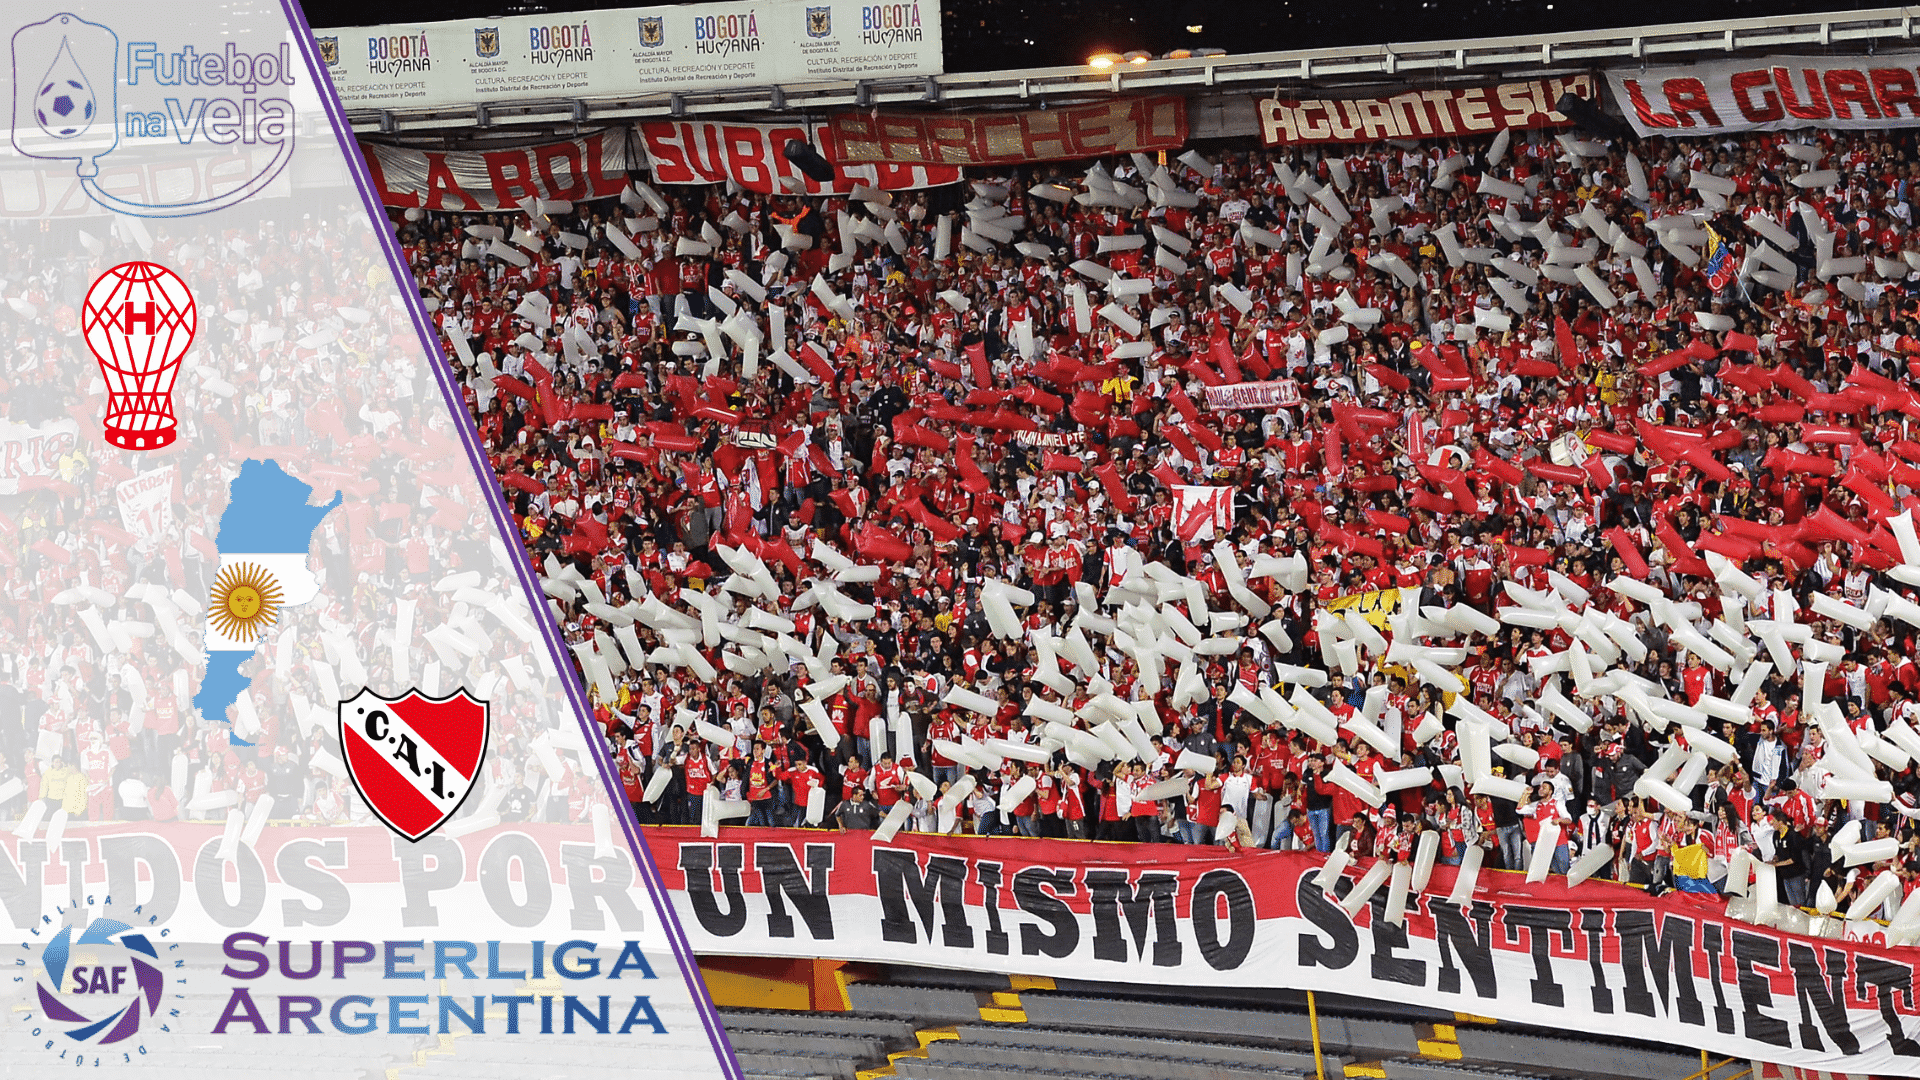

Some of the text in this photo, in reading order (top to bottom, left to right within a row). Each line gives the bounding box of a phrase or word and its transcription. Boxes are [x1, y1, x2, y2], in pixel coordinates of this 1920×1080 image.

[695, 9, 758, 39] BOGOTÁ
[862, 0, 921, 30] BOGOTÁ
[368, 30, 429, 60] BOGOTÁ
[530, 20, 592, 50] BOGOTÁ
[724, 62, 755, 71] DEPORTE
[889, 52, 917, 61] DEPORTE
[395, 81, 426, 89] DEPORTE
[557, 72, 588, 80] DEPORTE
[1259, 86, 1497, 144] AGUANTE
[1623, 77, 1724, 128] LA
[832, 97, 1188, 165] PARCHE 10
[392, 832, 646, 933] POR
[678, 842, 835, 941] UN
[871, 847, 1257, 972] MISMO
